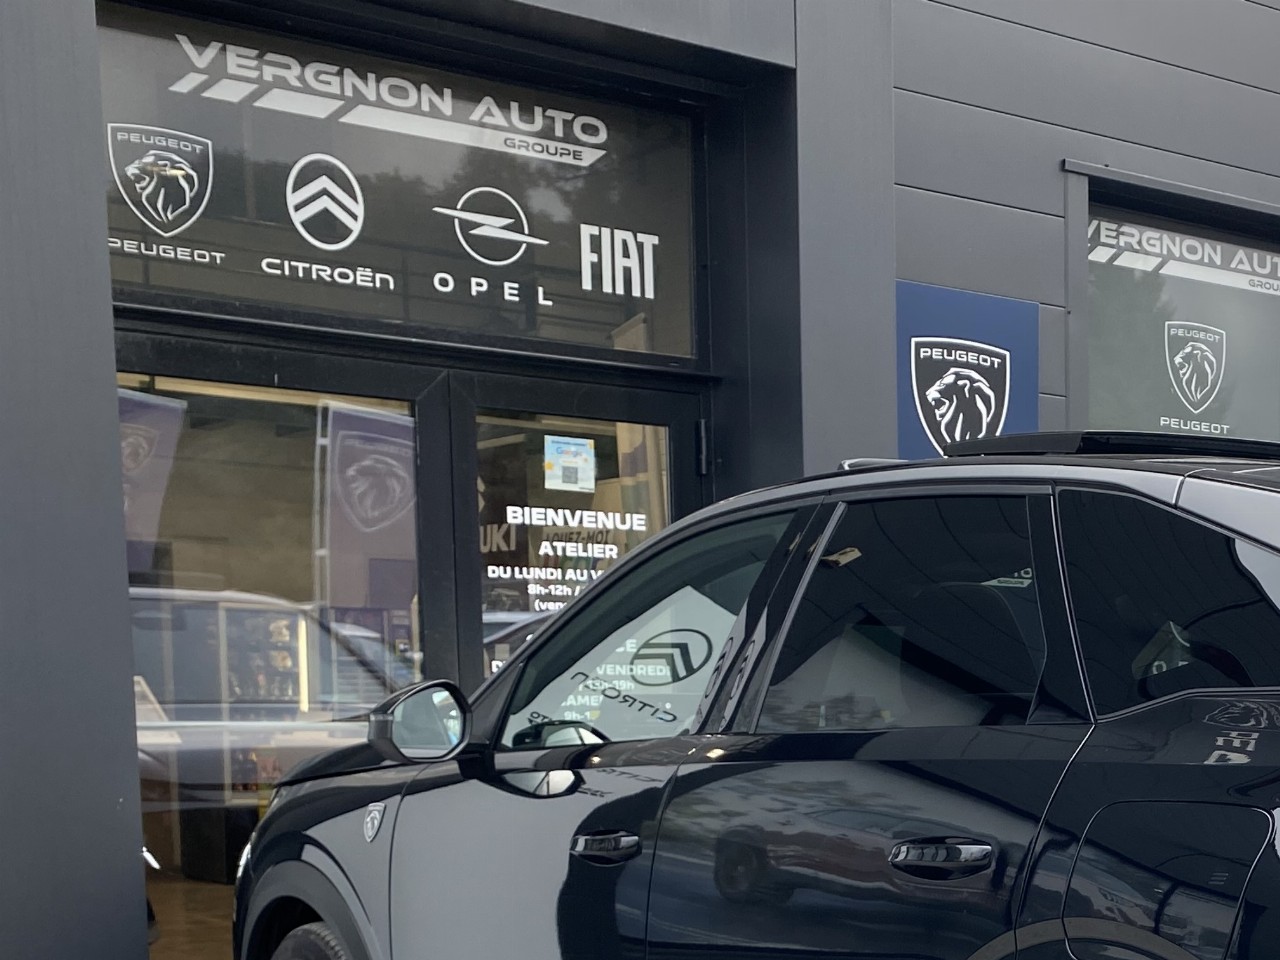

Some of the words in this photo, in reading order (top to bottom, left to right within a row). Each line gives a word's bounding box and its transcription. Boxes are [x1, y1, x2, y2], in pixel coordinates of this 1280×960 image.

[175, 34, 452, 116] VERGNON
[469, 96, 608, 144] AUTO
[116, 132, 204, 154] PEUGEOT
[503, 138, 583, 162] GROUPE
[107, 237, 225, 265] PEUGEOT
[580, 223, 659, 300] FIAT
[433, 272, 553, 306] OPEL
[1169, 327, 1221, 343] PEUGEOT
[920, 347, 1002, 369] PEUGEOT
[1159, 416, 1231, 436] PEUGEOT
[505, 504, 647, 532] BIENVENUE
[538, 540, 619, 560] ATELIER
[487, 565, 512, 579] DU
[514, 566, 562, 581] LUNDI
[565, 568, 589, 582] AU
[527, 583, 573, 597] 8h-12h
